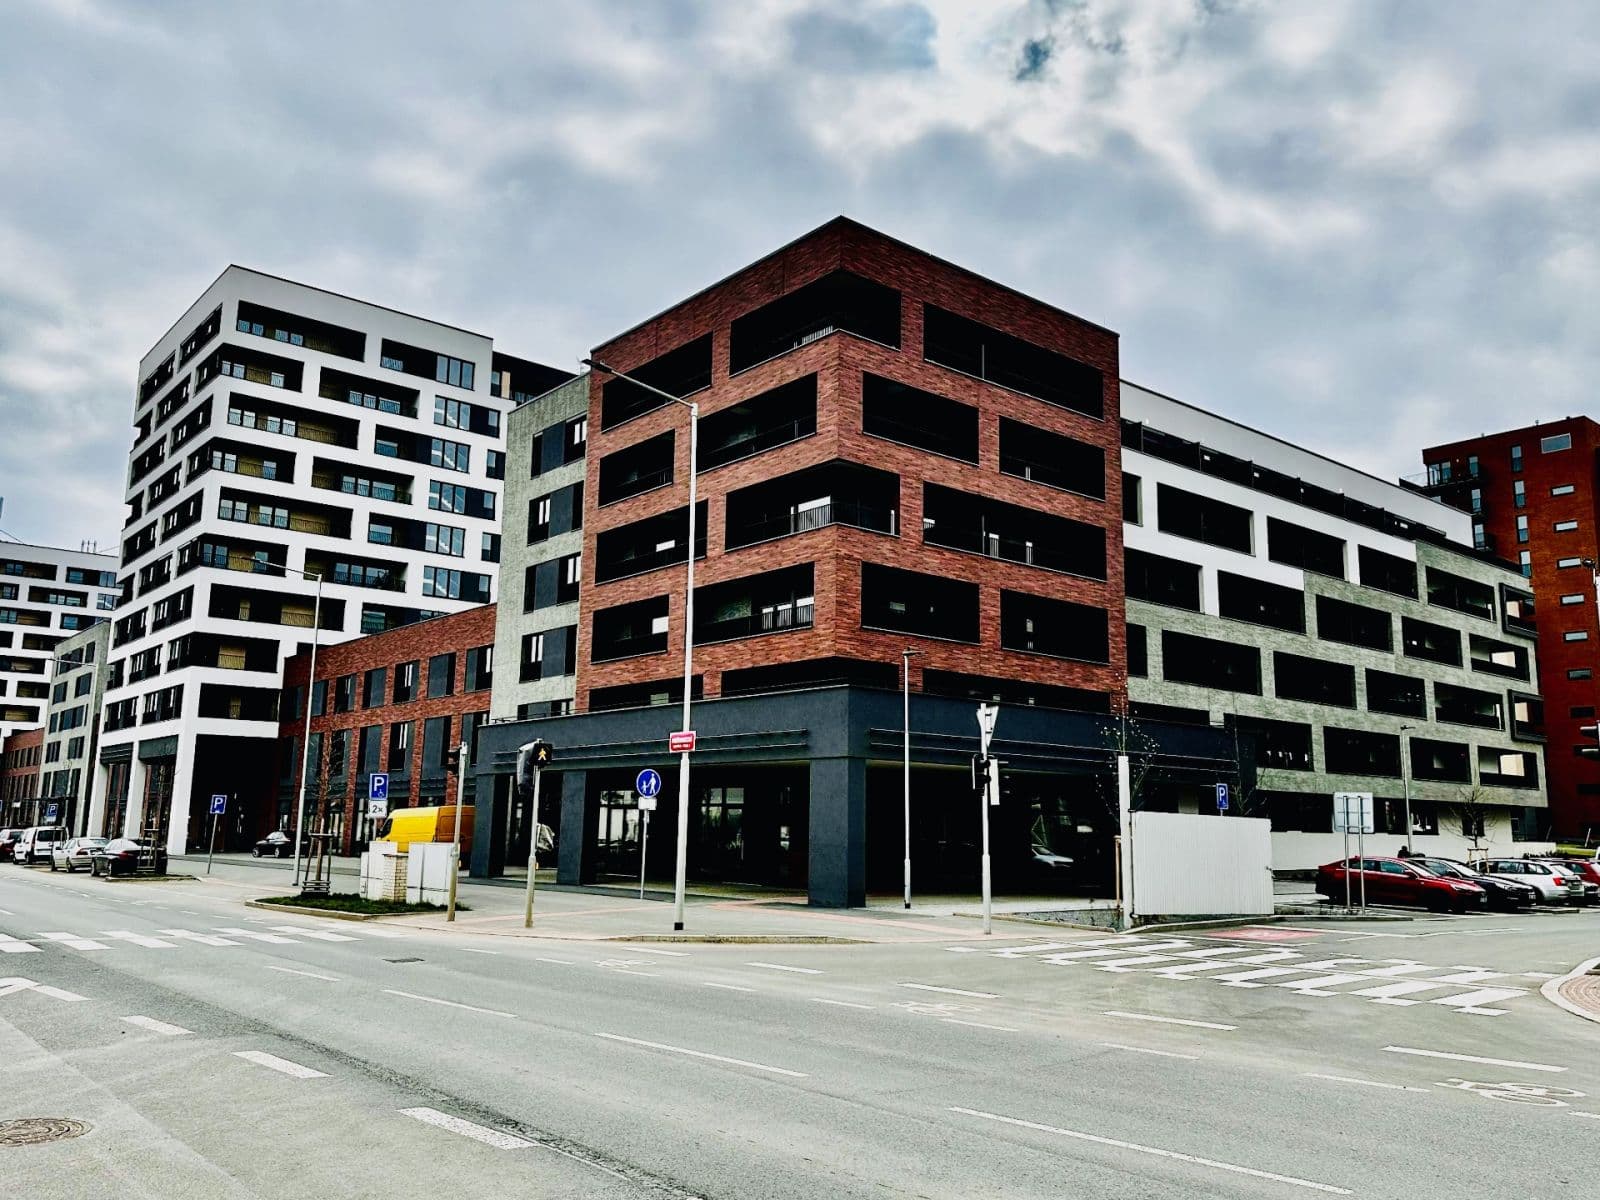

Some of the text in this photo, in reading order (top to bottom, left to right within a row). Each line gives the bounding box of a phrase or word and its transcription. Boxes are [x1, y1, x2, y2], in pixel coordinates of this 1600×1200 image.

[374, 776, 385, 791] P
[1219, 787, 1226, 801] P
[214, 797, 224, 808] P
